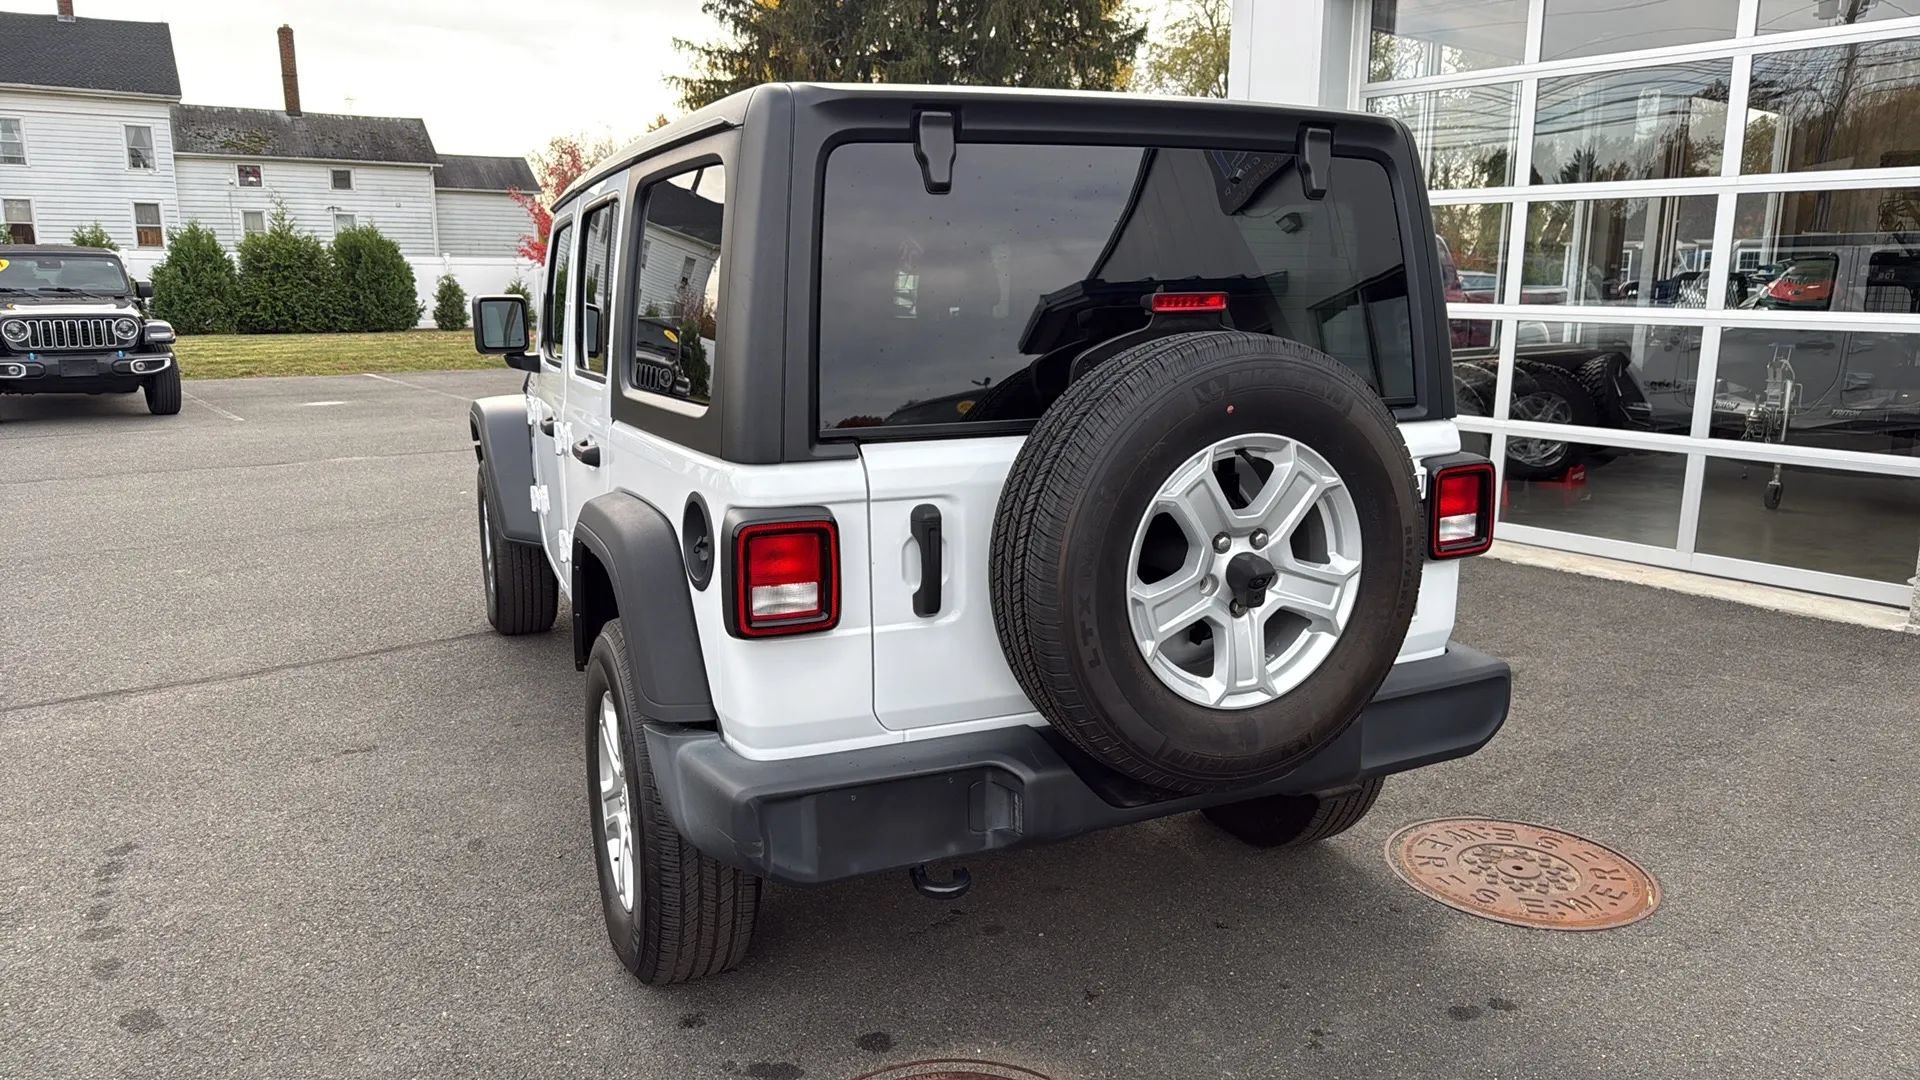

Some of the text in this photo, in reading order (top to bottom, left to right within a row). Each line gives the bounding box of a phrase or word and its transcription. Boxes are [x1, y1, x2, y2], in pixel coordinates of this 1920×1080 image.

[1078, 596, 1101, 669] LTX
[1414, 827, 1563, 870] SEWER
[1470, 867, 1628, 916] SEWER
